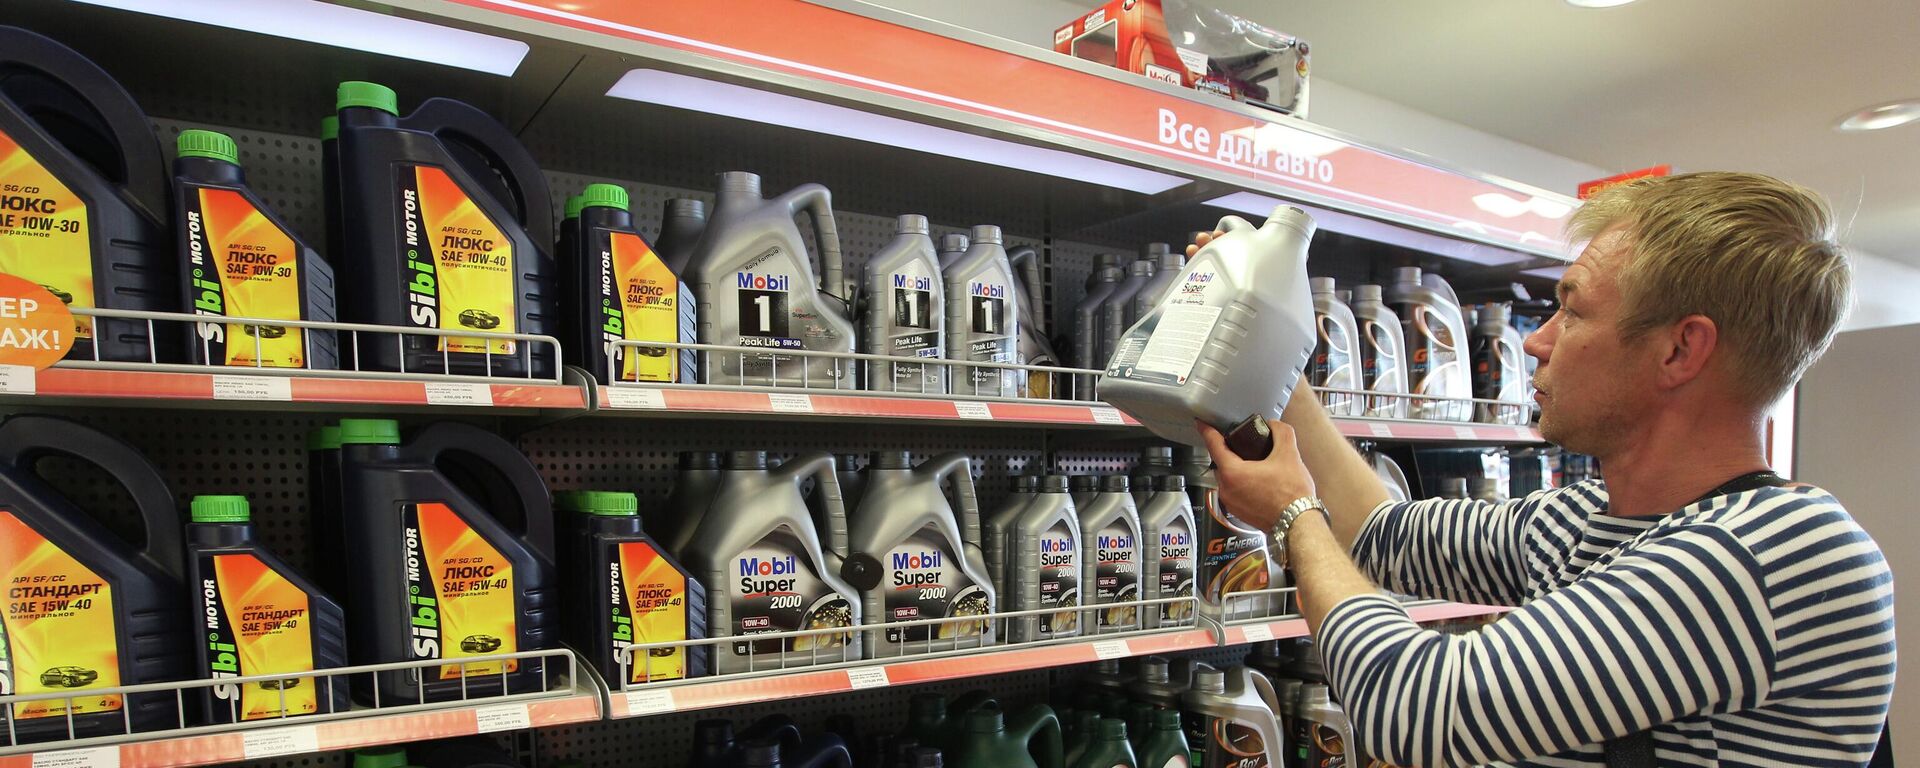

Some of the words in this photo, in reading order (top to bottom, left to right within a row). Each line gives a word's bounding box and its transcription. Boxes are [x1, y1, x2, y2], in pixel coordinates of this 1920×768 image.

[1158, 108, 1210, 153] Все
[1274, 151, 1335, 183] авто
[4, 184, 40, 194] SG/CD
[0, 195, 57, 214] ЮКС
[404, 189, 419, 246] MOTOR
[21, 216, 80, 235] 10W-30
[441, 226, 456, 234] API
[457, 227, 482, 236] SG/CD
[188, 211, 203, 266] MOTOR
[441, 236, 494, 252] ЛЮКС
[226, 250, 278, 266] ЛЮКС
[441, 250, 463, 262] SAE
[467, 252, 507, 267] 10W-40
[226, 263, 248, 275] SAE
[252, 264, 292, 279] 10W-30
[602, 251, 611, 295] MOTOR
[1187, 272, 1215, 283] Mobil
[737, 272, 789, 291] Mobil
[894, 274, 931, 291] Mobil
[1181, 282, 1207, 294] Super
[627, 285, 664, 297] ЛЮКС
[971, 282, 1004, 298] Mobil
[0, 296, 38, 320] ЕР
[627, 294, 643, 304] SAE
[646, 295, 673, 307] 10W-40
[754, 295, 771, 332] 1
[906, 293, 919, 327] 1
[981, 300, 993, 332] 1
[0, 326, 61, 351] АЖ!
[739, 337, 763, 347] Peak
[764, 338, 781, 347] Life
[782, 338, 801, 347] 5W-50
[895, 338, 911, 346] Peak
[911, 336, 922, 344] Life
[972, 342, 986, 351] Peak
[986, 341, 996, 349] Life
[918, 348, 937, 357] 5W-50
[1041, 537, 1073, 553] Mobil
[1098, 534, 1132, 549] Mobil
[1161, 532, 1190, 547] Mobil
[406, 527, 420, 581] MOTOR
[893, 551, 941, 570] Mobil
[1041, 553, 1073, 568] Super
[1098, 550, 1132, 565] Super
[1161, 546, 1190, 560] Super
[443, 557, 458, 565] API
[740, 556, 796, 577] Mobil
[1175, 560, 1192, 569] 2000
[443, 564, 495, 580] ЛЮКС
[1057, 567, 1076, 578] 2000
[1115, 564, 1135, 574] 2000
[11, 575, 31, 584] API
[32, 574, 67, 583] SF/CC
[442, 581, 464, 593] SAE
[468, 578, 508, 592] 15W-40
[611, 563, 620, 605] MOTOR
[893, 570, 942, 588] Super
[9, 583, 102, 599] СТАНДАРТ
[636, 589, 672, 600] ЛЮКС
[740, 577, 797, 597] Super
[918, 587, 947, 600] 2000
[9, 601, 37, 614] SAE
[41, 598, 92, 612] 15W-40
[203, 579, 219, 630] MOTOR
[636, 600, 652, 609] SAE
[654, 598, 682, 608] 15W-40
[770, 595, 802, 610] 2000
[9, 611, 76, 620] минеральное
[242, 609, 304, 621] СТАНДАРТ
[896, 609, 917, 617] 10W-40
[241, 622, 260, 633] SAE
[263, 620, 298, 631] 15W-40
[744, 619, 768, 627] 10W-40
